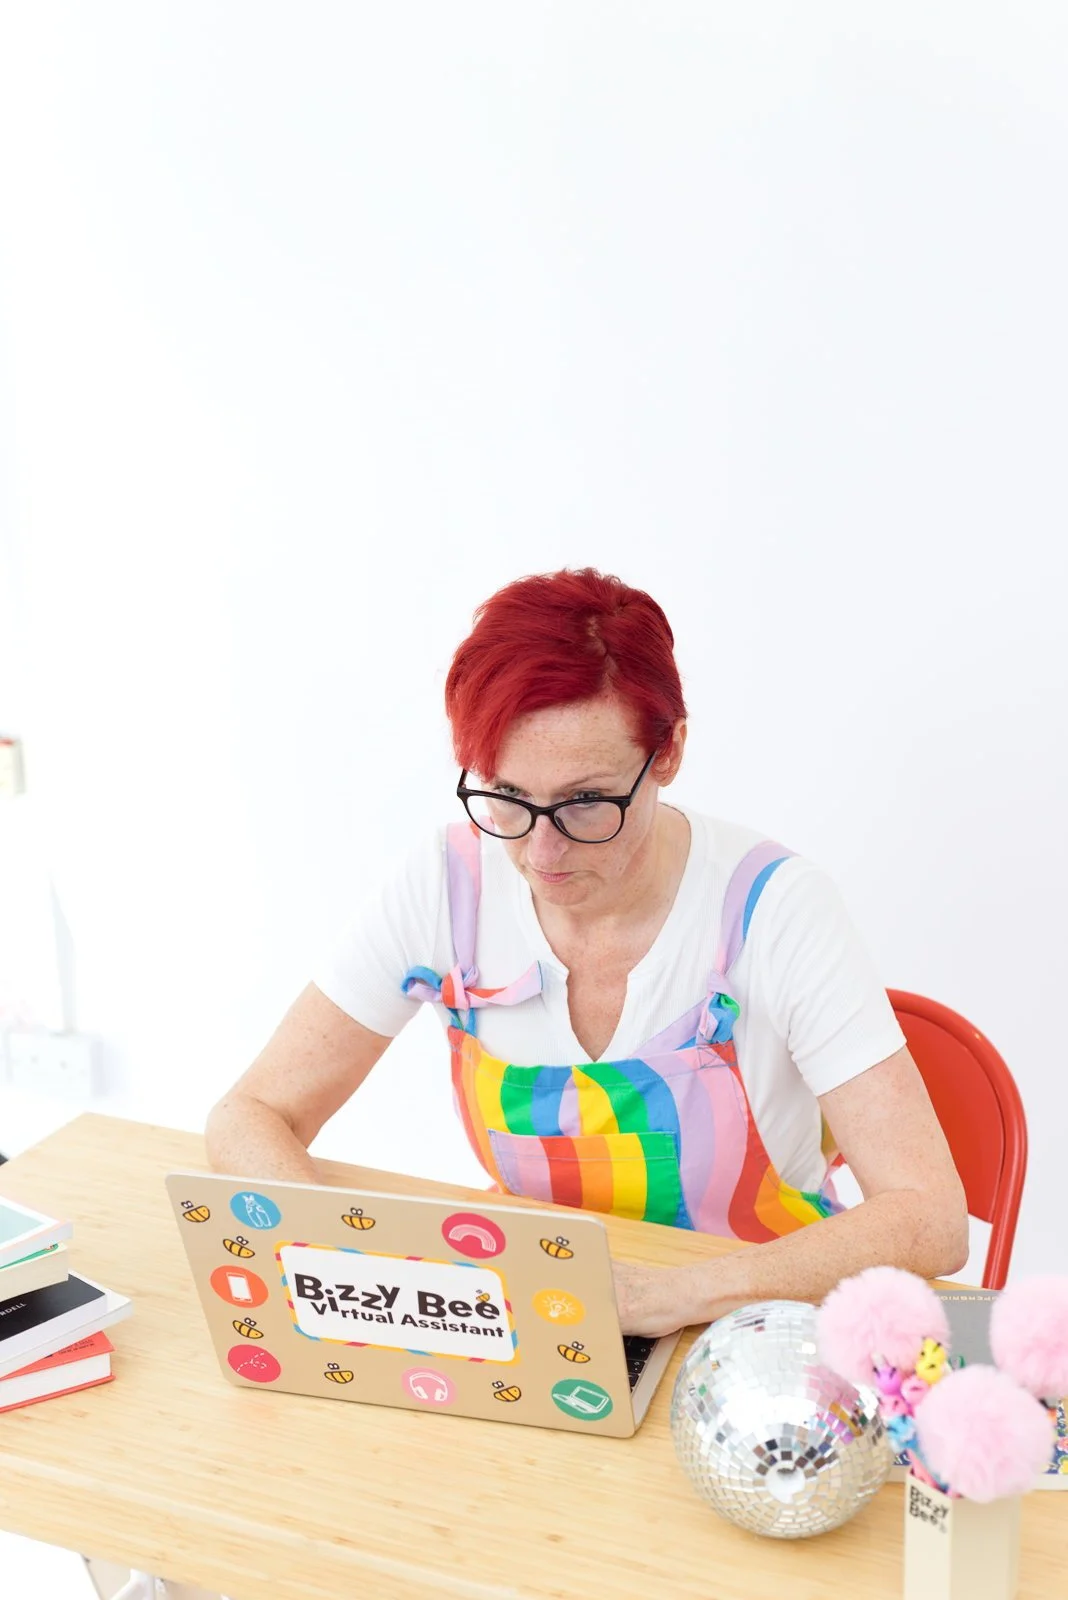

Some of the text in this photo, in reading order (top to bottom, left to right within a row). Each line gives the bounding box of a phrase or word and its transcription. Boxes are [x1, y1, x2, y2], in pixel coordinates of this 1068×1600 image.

[294, 1273, 500, 1320] Bizzy Bee
[401, 1314, 504, 1338] Assistant
